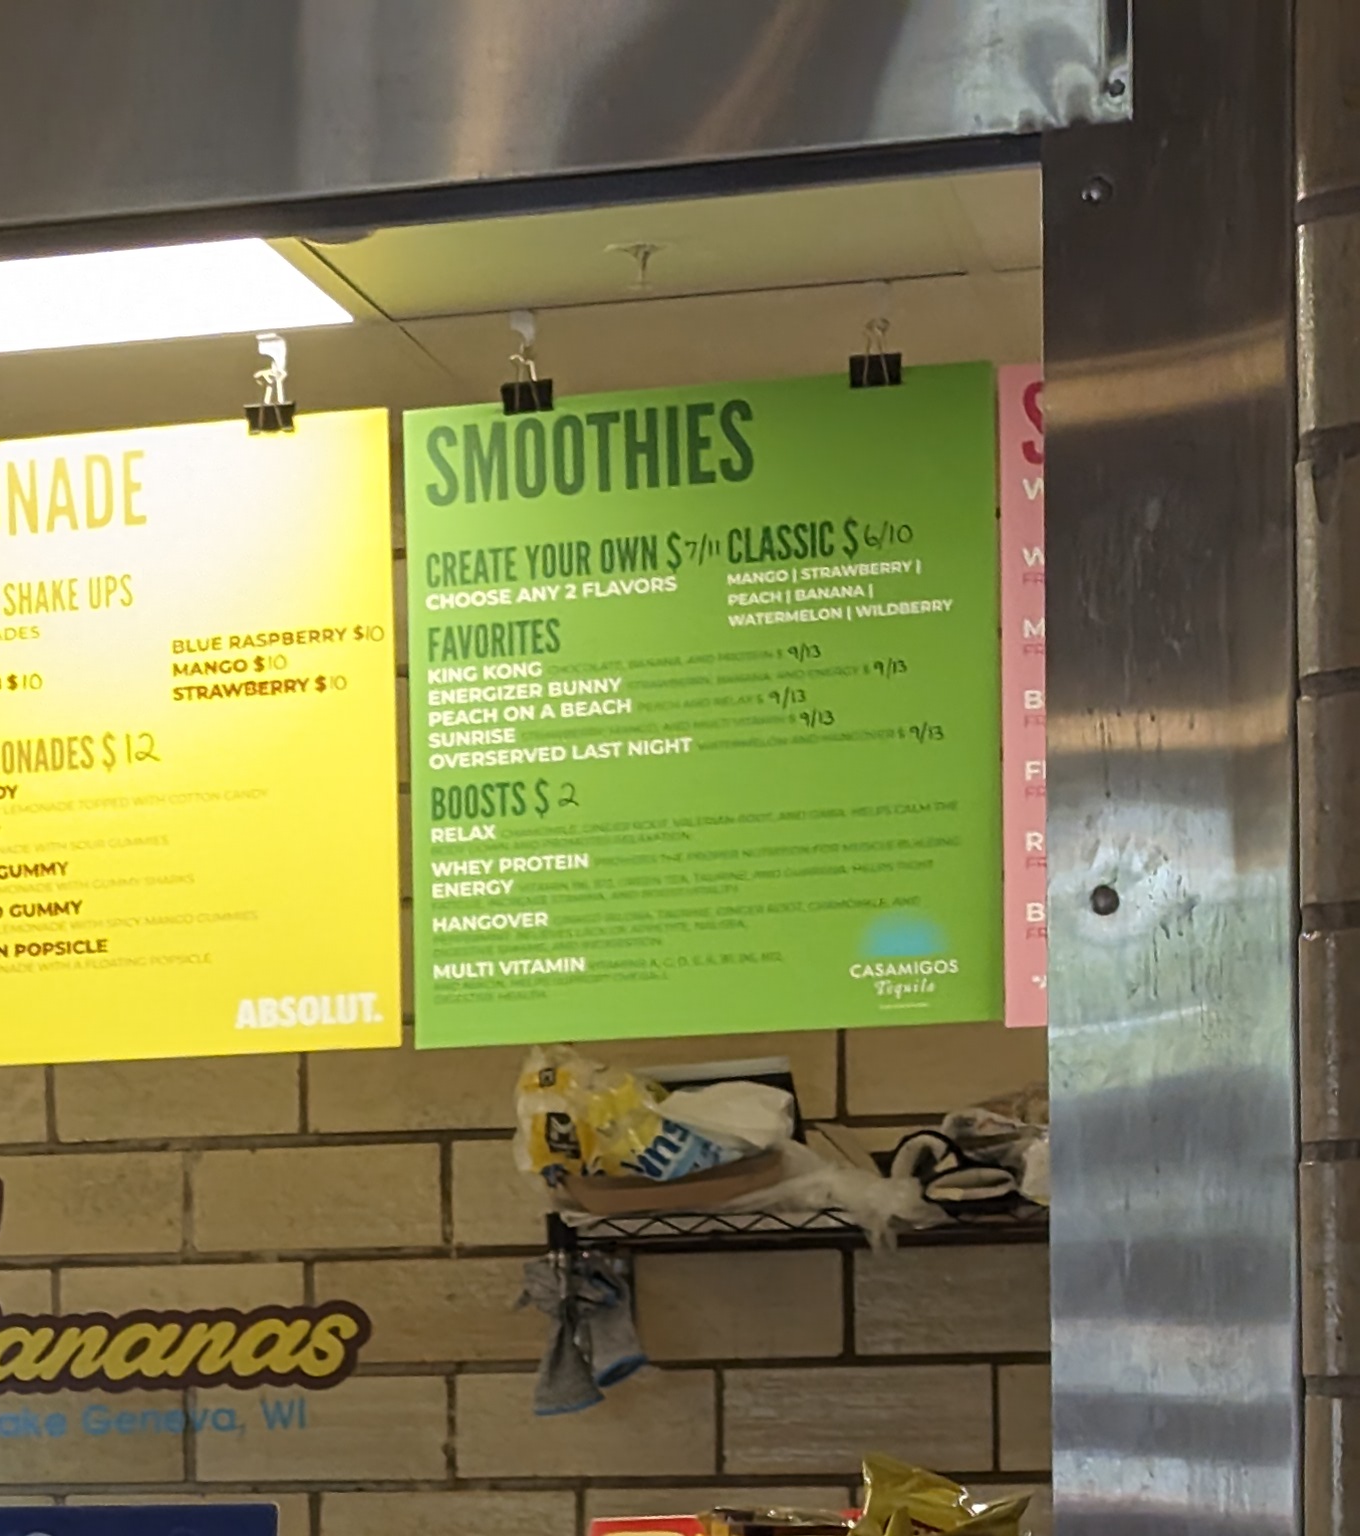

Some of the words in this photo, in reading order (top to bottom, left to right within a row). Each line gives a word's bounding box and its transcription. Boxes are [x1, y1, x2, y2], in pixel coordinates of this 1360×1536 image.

[426, 398, 755, 507] SMOOTHIES
[727, 521, 834, 566] CLASSIC
[426, 547, 517, 589] CREATE
[525, 542, 591, 583] YOUR
[600, 537, 657, 576] OWN
[727, 567, 788, 587] MANGO
[801, 559, 912, 581] STRAWBERRY
[3, 578, 79, 616] SHAKE
[88, 574, 133, 609] UPS
[426, 589, 511, 611] CHOOSE
[518, 585, 560, 605] ANY
[565, 583, 577, 601] 2
[583, 576, 677, 600] FLAVORS
[728, 604, 843, 628] WATERMELON
[856, 598, 953, 620] WILDBERRY
[427, 618, 561, 662] FAVORITES
[427, 665, 478, 684] KING
[483, 661, 543, 680] KONG
[428, 682, 543, 706] ENERGIZER
[548, 677, 622, 698] BUNNY
[428, 707, 496, 728] PEACH
[504, 704, 533, 722] ON
[540, 703, 554, 720] A
[560, 698, 632, 718] BEACH
[428, 728, 516, 748] SUNRISE
[429, 744, 565, 771] OVERSERVED
[572, 741, 620, 761] LAST
[627, 737, 694, 757] NIGHT
[431, 781, 525, 821] BOOSTS
[431, 824, 496, 843] RELAX
[432, 859, 493, 877] WHEY
[499, 853, 589, 873] PROTEIN
[432, 879, 514, 899] ENERGY
[9, 900, 82, 919] GUMMY
[432, 912, 548, 932] HANGOVER
[14, 938, 108, 957] POPSICLE
[433, 961, 494, 979] MULTI
[499, 957, 586, 976] VITAMIN
[849, 959, 958, 979] CASAMIGOS
[80, 1398, 246, 1437] Geneva,
[264, 1397, 307, 1431] WI
